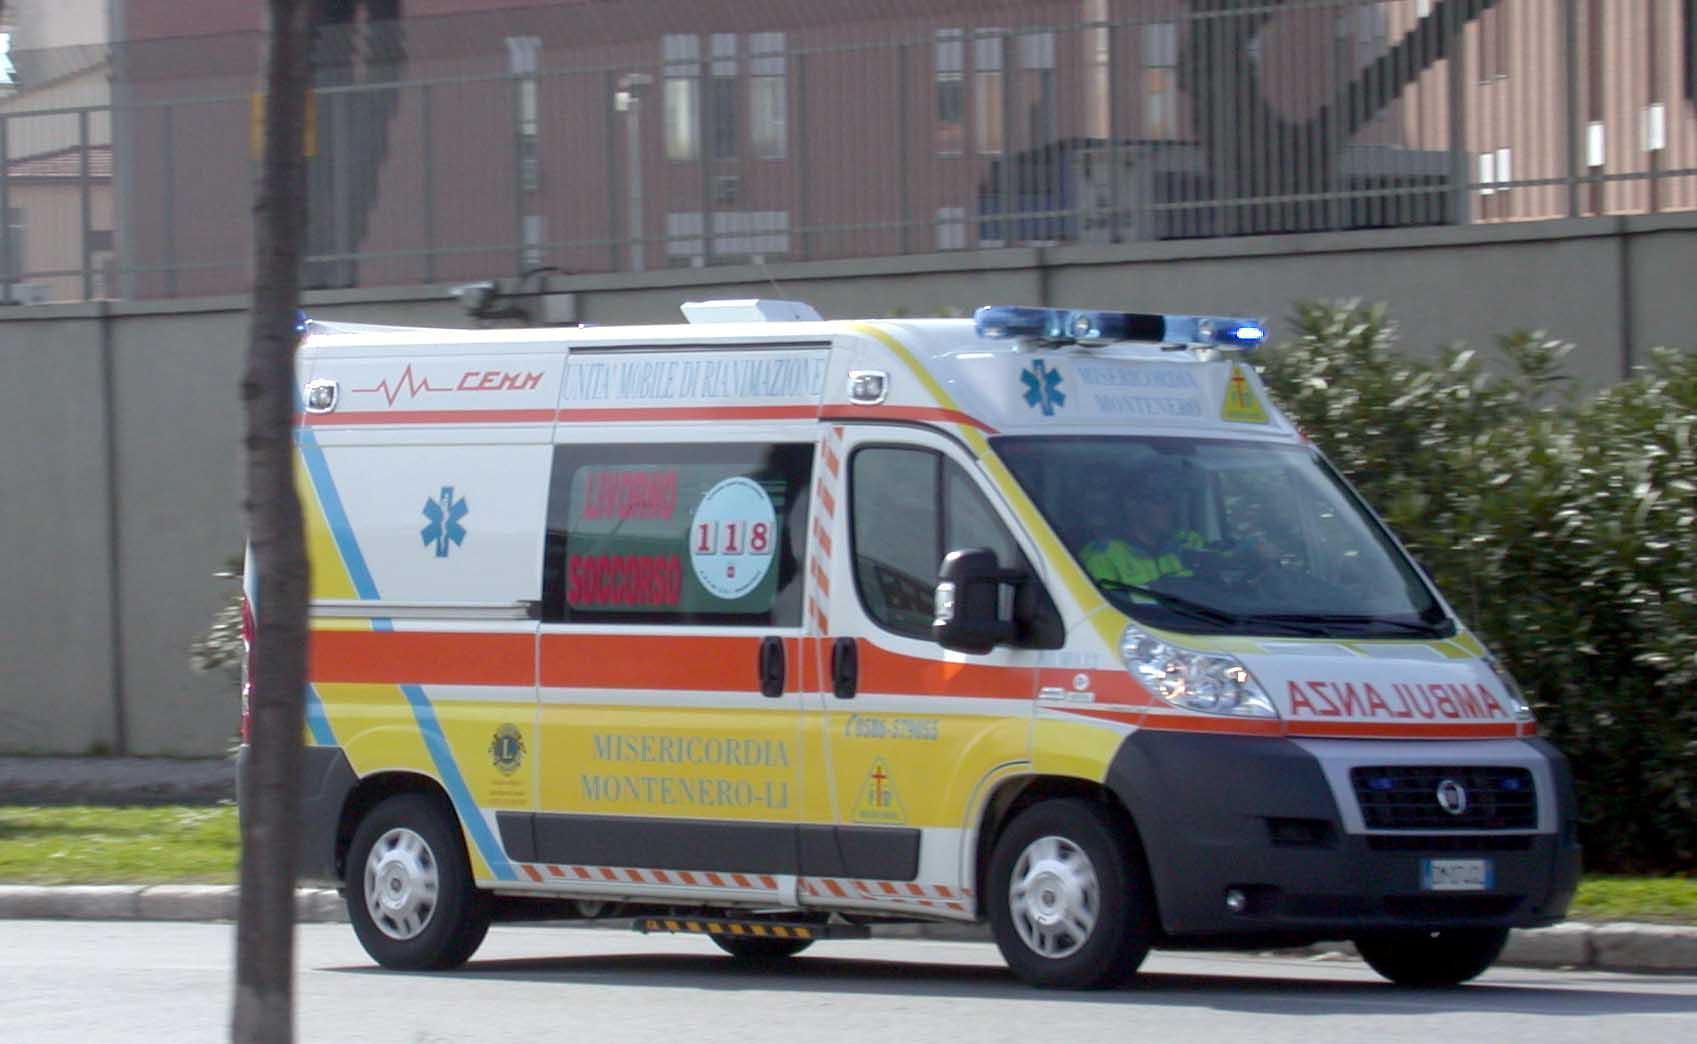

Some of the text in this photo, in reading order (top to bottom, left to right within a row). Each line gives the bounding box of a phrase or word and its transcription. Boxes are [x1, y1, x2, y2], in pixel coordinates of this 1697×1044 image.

[617, 360, 677, 399] MOBILE
[583, 470, 677, 521] LIVORNO
[697, 522, 767, 553] 118
[568, 553, 683, 606] SOCCORSO
[592, 734, 790, 768] MISERICORDIA
[580, 774, 790, 809] MONTENERO-LI
